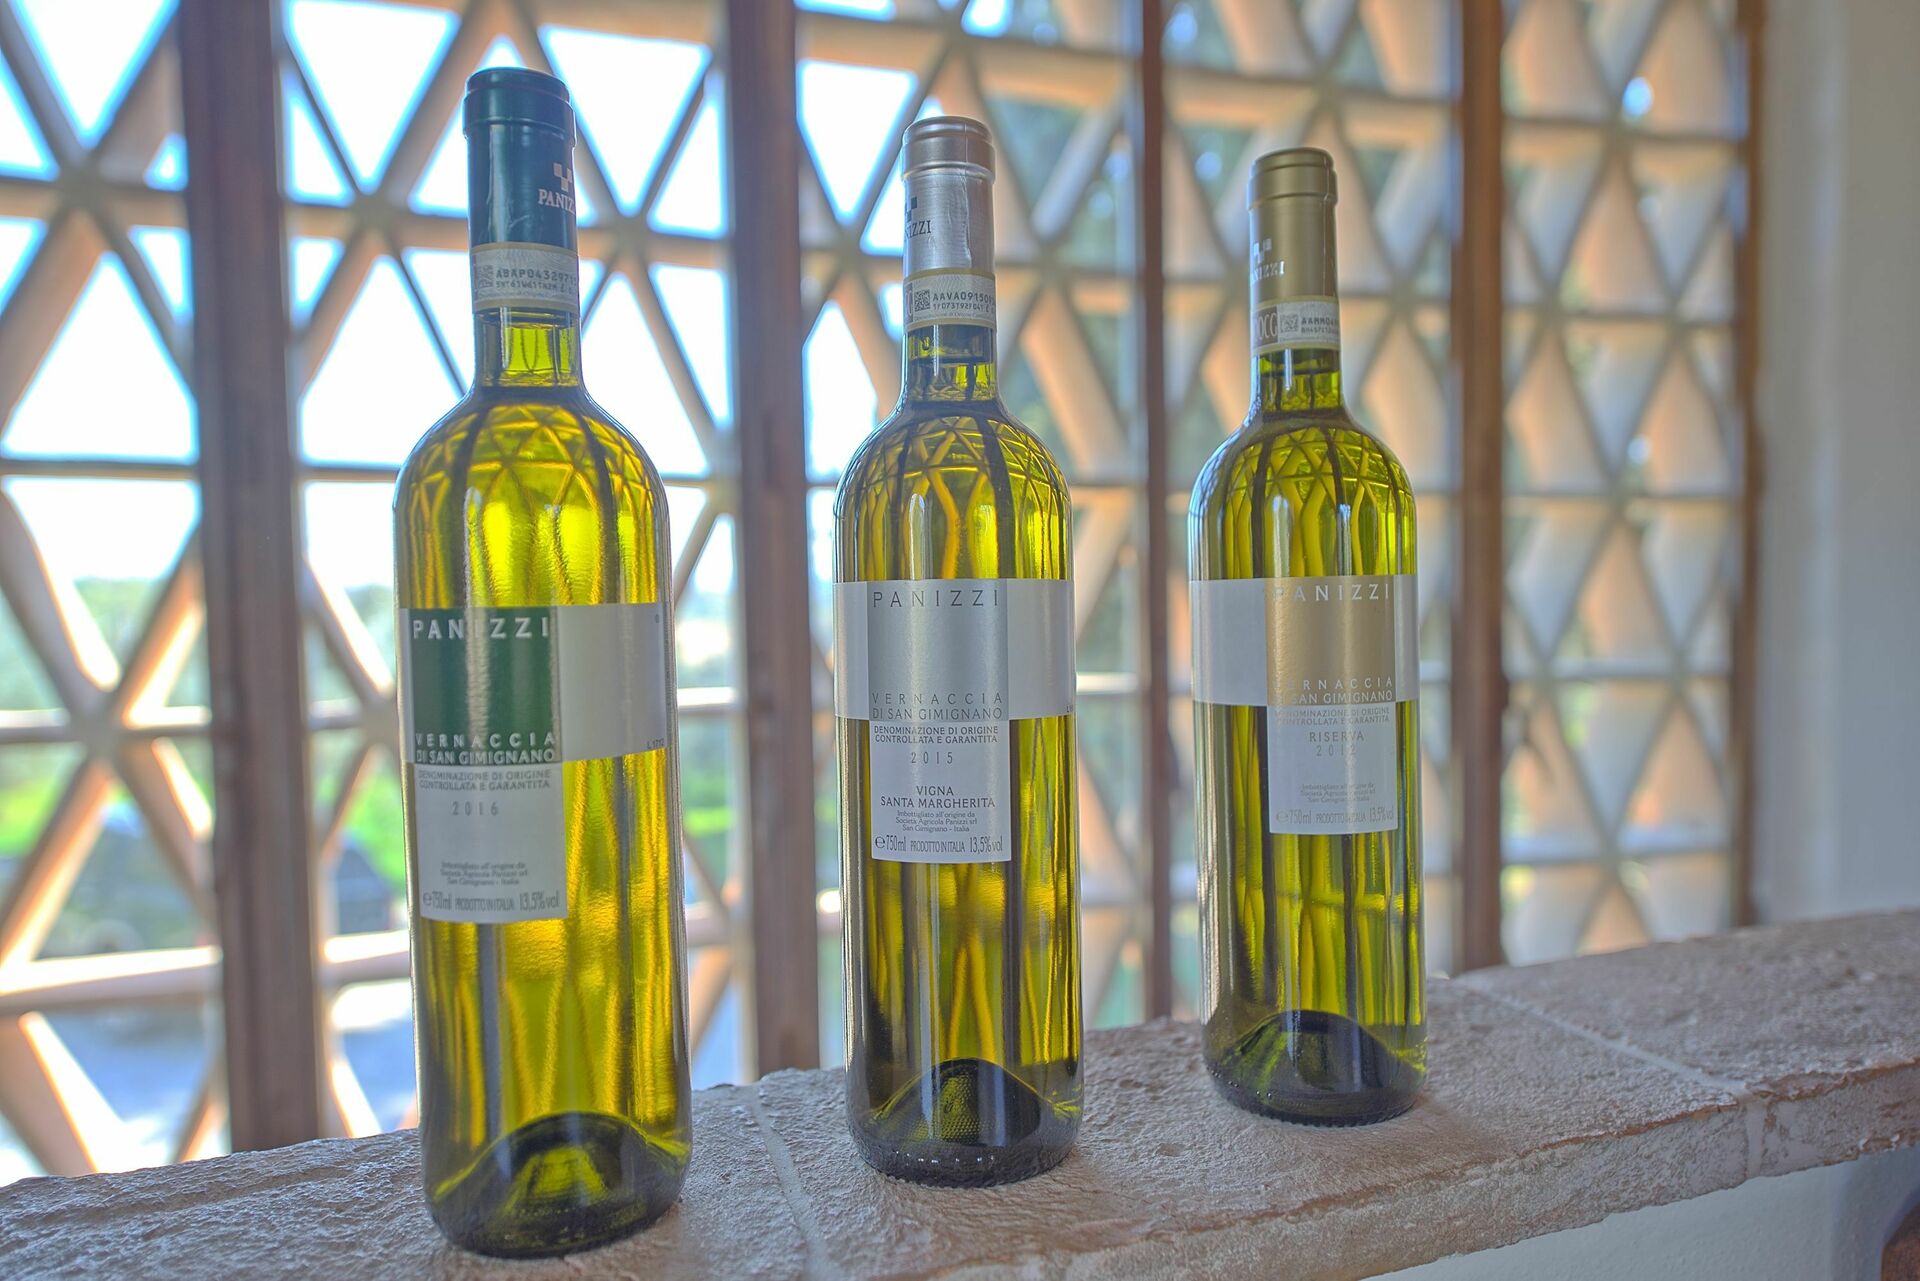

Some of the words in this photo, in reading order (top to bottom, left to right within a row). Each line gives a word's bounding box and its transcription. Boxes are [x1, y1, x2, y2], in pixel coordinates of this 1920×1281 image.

[872, 589, 999, 608] PANIZZI
[413, 617, 549, 640] PANIZZI
[872, 691, 1003, 705] VERNACCIA
[1322, 690, 1393, 704] GIMIGNANO
[872, 707, 883, 720] DI
[887, 707, 913, 720] SAN
[917, 706, 1003, 721] GIMIGNANO
[1361, 706, 1390, 716] ORIGINE
[873, 725, 946, 736] DENOMINAZIONE
[948, 725, 959, 735] DI
[961, 725, 999, 735] ORIGINE
[415, 731, 557, 750] VERNACCIA
[875, 734, 935, 744] CONTROLLATA
[936, 735, 943, 744] E
[945, 734, 998, 745] GARANTITA
[1309, 731, 1365, 743] RISERVA
[416, 750, 428, 763] DI
[429, 749, 455, 764] SAN
[458, 748, 556, 765] GIMIGNANO
[911, 751, 954, 765] 2015
[491, 770, 503, 781] DI
[505, 769, 552, 780] ORIGINE
[479, 781, 486, 791] E
[488, 780, 551, 791] GARANTITA
[916, 785, 954, 796] VIGNA
[451, 800, 500, 816] 2016
[880, 796, 916, 808] SANTA
[918, 796, 996, 809] MARGHERITA
[967, 810, 976, 818] da
[918, 817, 945, 826] Agricola
[945, 817, 968, 826] Panizzi
[969, 817, 978, 826] srl
[915, 825, 948, 834] Gimignano
[954, 825, 970, 833] Italia
